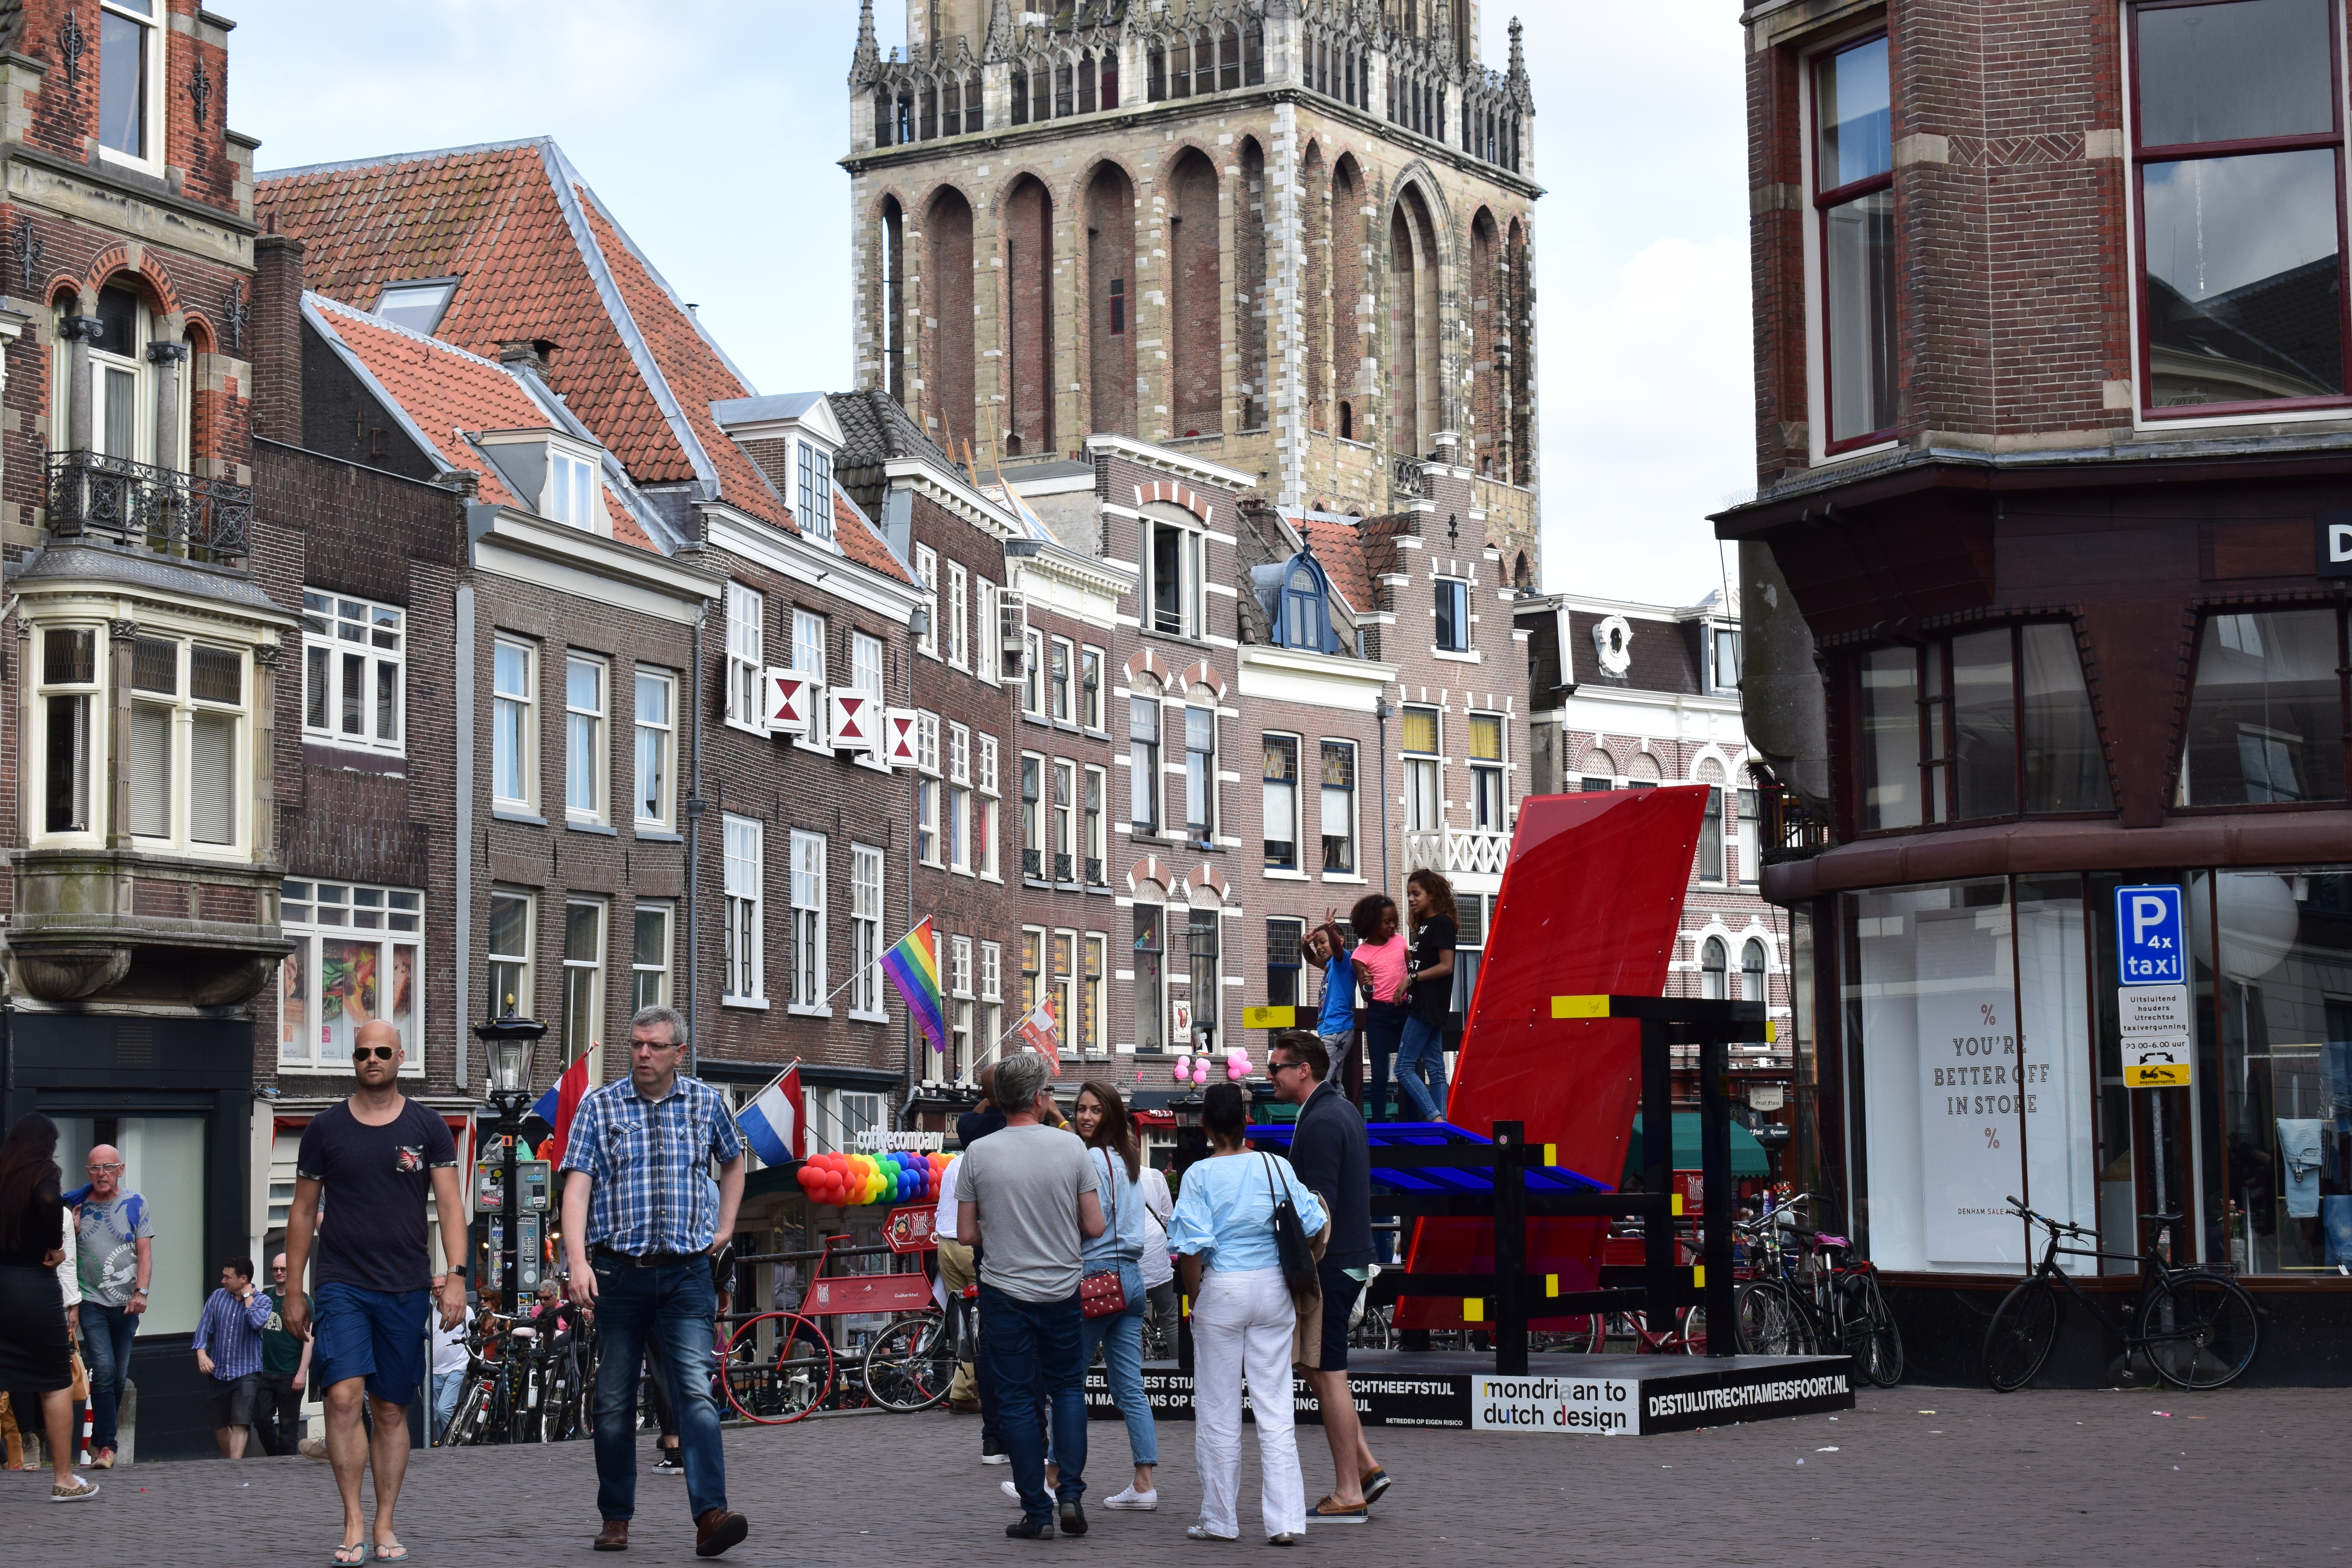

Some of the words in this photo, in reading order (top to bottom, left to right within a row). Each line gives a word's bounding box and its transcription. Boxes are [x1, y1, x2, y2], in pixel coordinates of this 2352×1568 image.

[2132, 896, 2166, 944] P
[2148, 935, 2172, 949] 4x
[2128, 955, 2177, 975] taxi
[1934, 1066, 2006, 1086] BETTER
[2012, 1064, 2049, 1083] OFF
[1947, 1096, 1967, 1114] IN
[1975, 1094, 2036, 1114] STORE
[947, 1114, 961, 1133] BET
[857, 1125, 944, 1154] coffeecompany
[1690, 1185, 1703, 1195] HUIS
[913, 1212, 926, 1222] Stad
[914, 1221, 927, 1230] HUIS
[1085, 1375, 1107, 1387] EEL
[1169, 1376, 1194, 1389] STIJ
[1347, 1380, 1455, 1395] ECHTHEEFTSTIJL
[1484, 1378, 1599, 1401] mondriaan
[1604, 1381, 1626, 1402] to
[1170, 1395, 1188, 1406] OP
[1649, 1374, 1849, 1417] DESTIJLUTRECHTAMERSFOORT.NL
[1484, 1403, 1544, 1425] dutch
[1553, 1405, 1626, 1432] design
